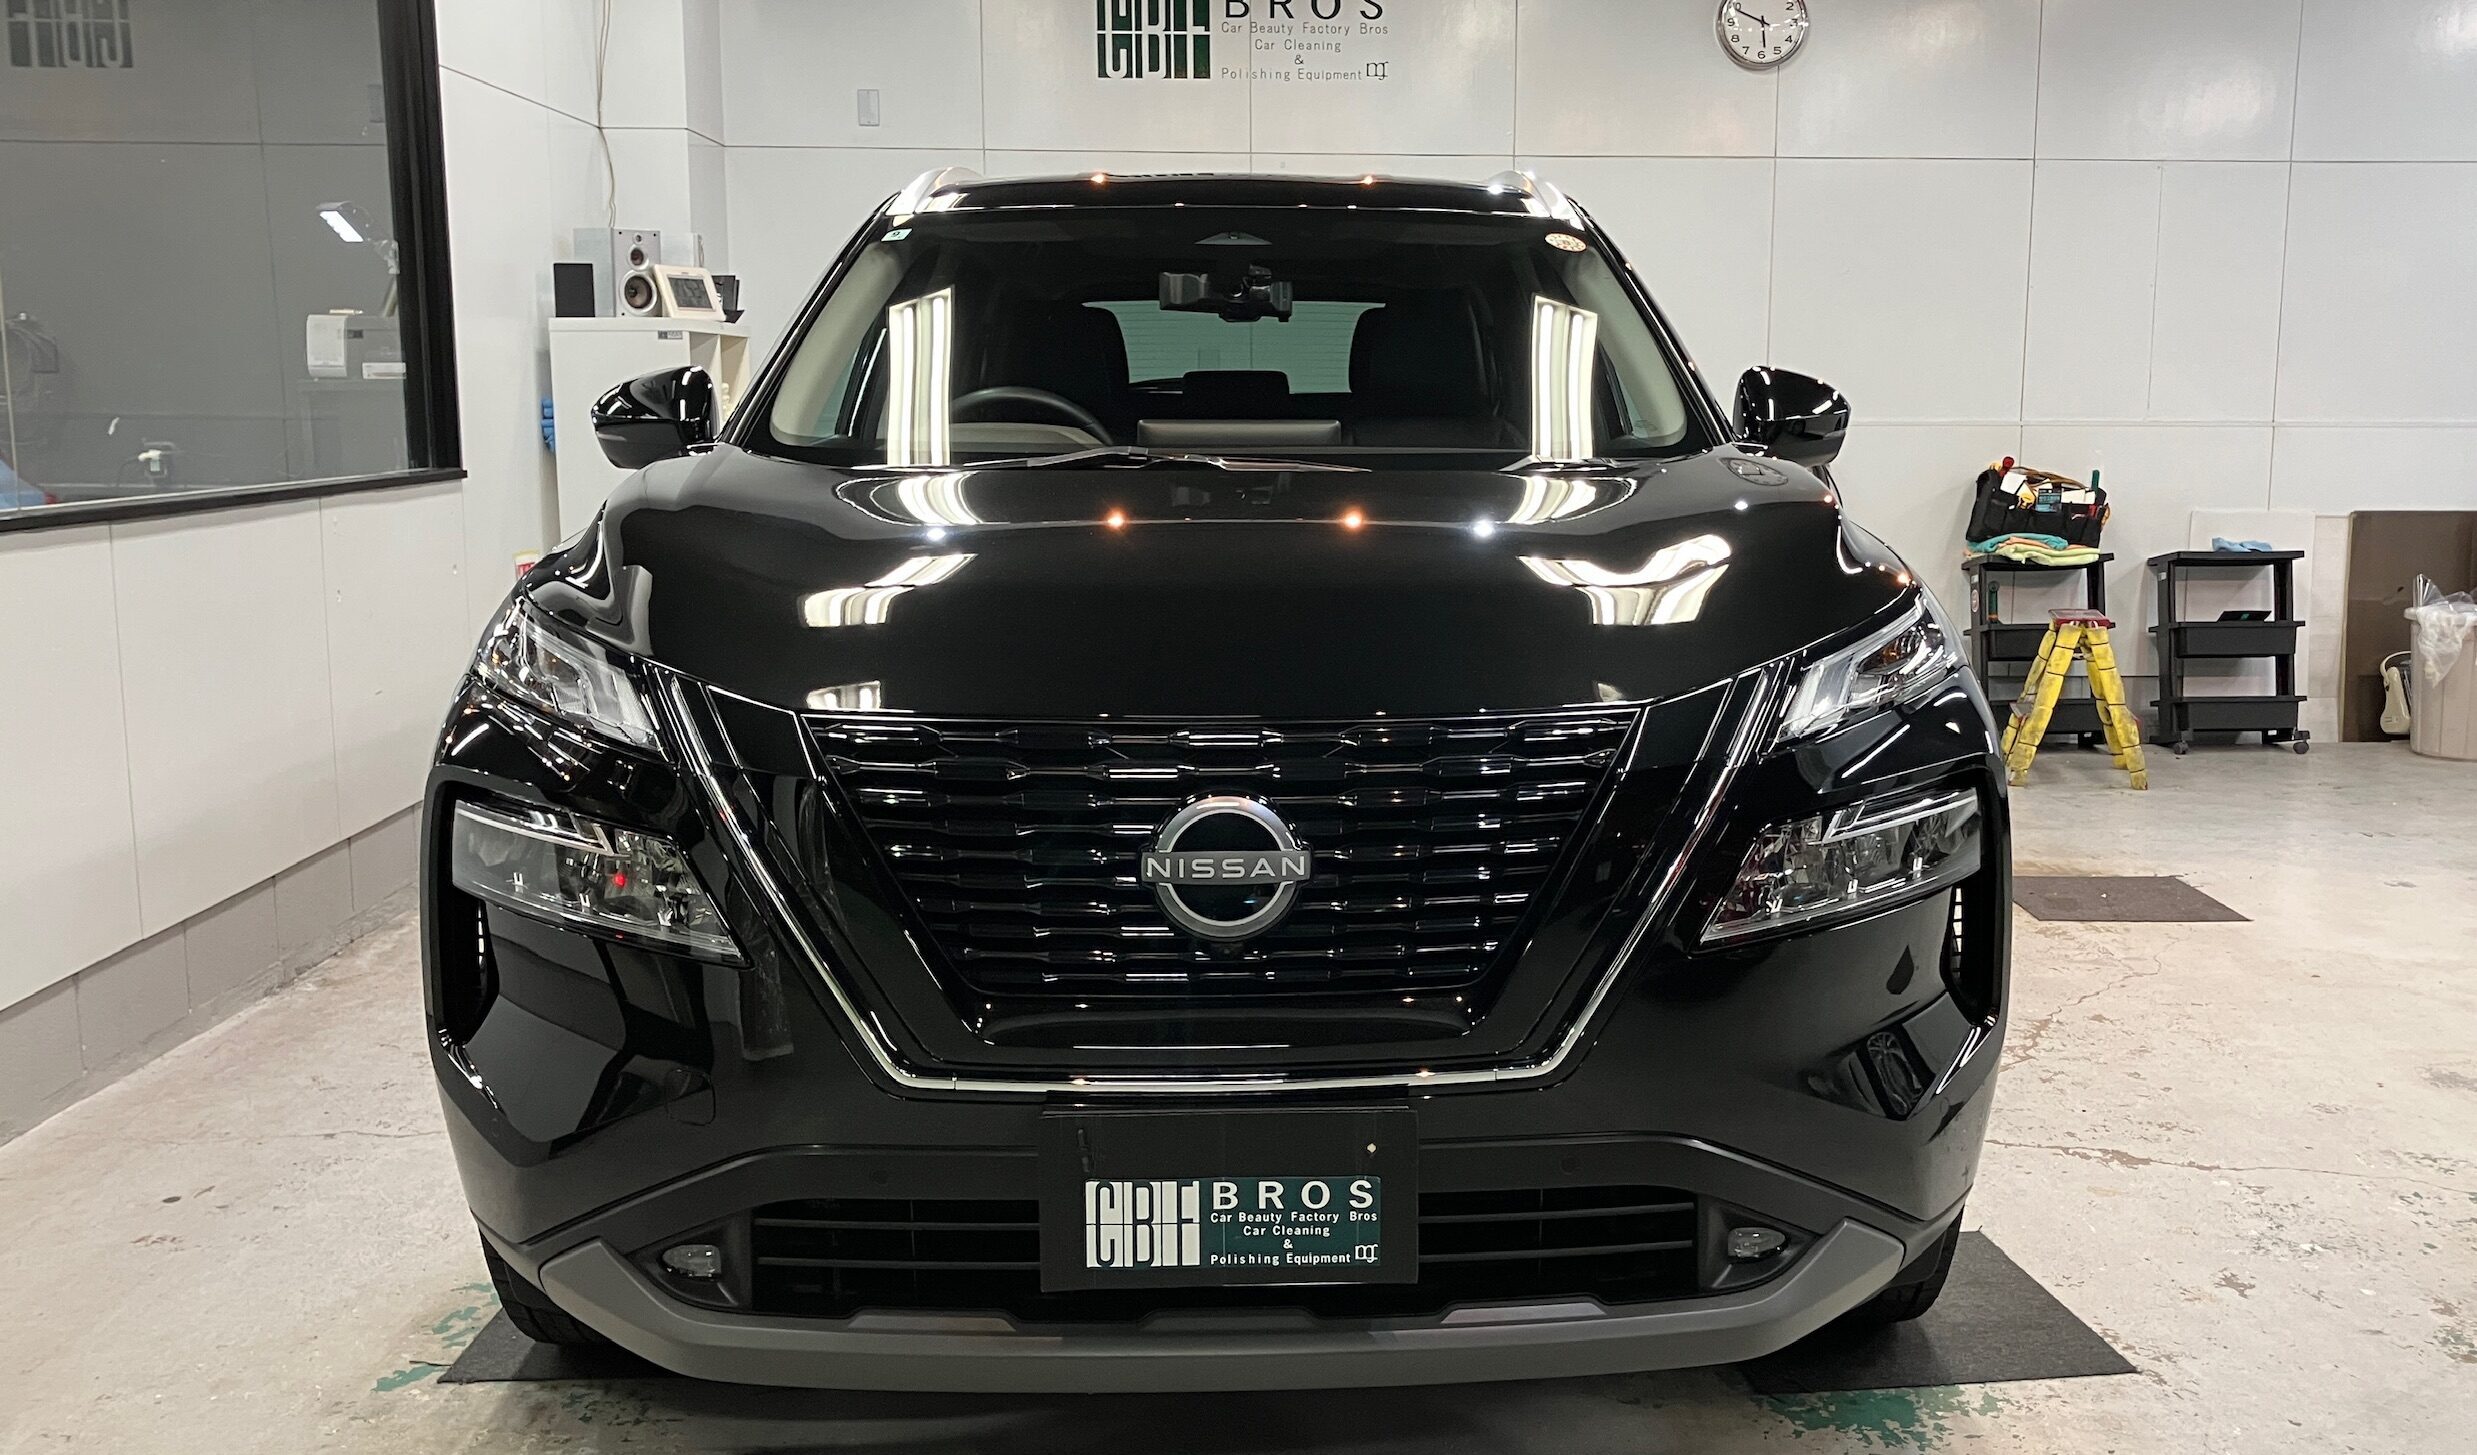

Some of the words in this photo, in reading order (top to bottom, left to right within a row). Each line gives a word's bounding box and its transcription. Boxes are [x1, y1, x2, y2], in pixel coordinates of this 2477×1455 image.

[1225, 0, 1383, 20] BROS
[1785, 2, 1794, 11] 2
[1727, 18, 1735, 27] 9
[1789, 18, 1798, 27] 3
[1221, 21, 1242, 33] Car
[1250, 21, 1293, 36] Beauty
[1302, 21, 1350, 36] Factory
[1359, 22, 1388, 35] Bros
[1730, 35, 1740, 43] 8
[1784, 35, 1793, 43] 4
[1254, 38, 1275, 50] Car
[1284, 38, 1341, 52] Cleaning
[1742, 46, 1750, 55] 7
[1773, 46, 1782, 55] 5
[1294, 54, 1304, 65] &
[1757, 50, 1766, 59] 6
[1221, 67, 1291, 81] Polishing
[1297, 68, 1362, 81] Equipment
[1147, 856, 1305, 879] NISSAN
[1212, 1180, 1374, 1210] BROS
[1210, 1212, 1232, 1223] Car
[1238, 1212, 1282, 1224] Beauty
[1290, 1211, 1340, 1224] Factory
[1349, 1211, 1378, 1222] Bros
[1243, 1225, 1266, 1236] Car
[1272, 1225, 1331, 1237] Cleaning
[1282, 1238, 1294, 1249] &
[1210, 1254, 1280, 1266] Polishing
[1286, 1252, 1351, 1265] Equipment
